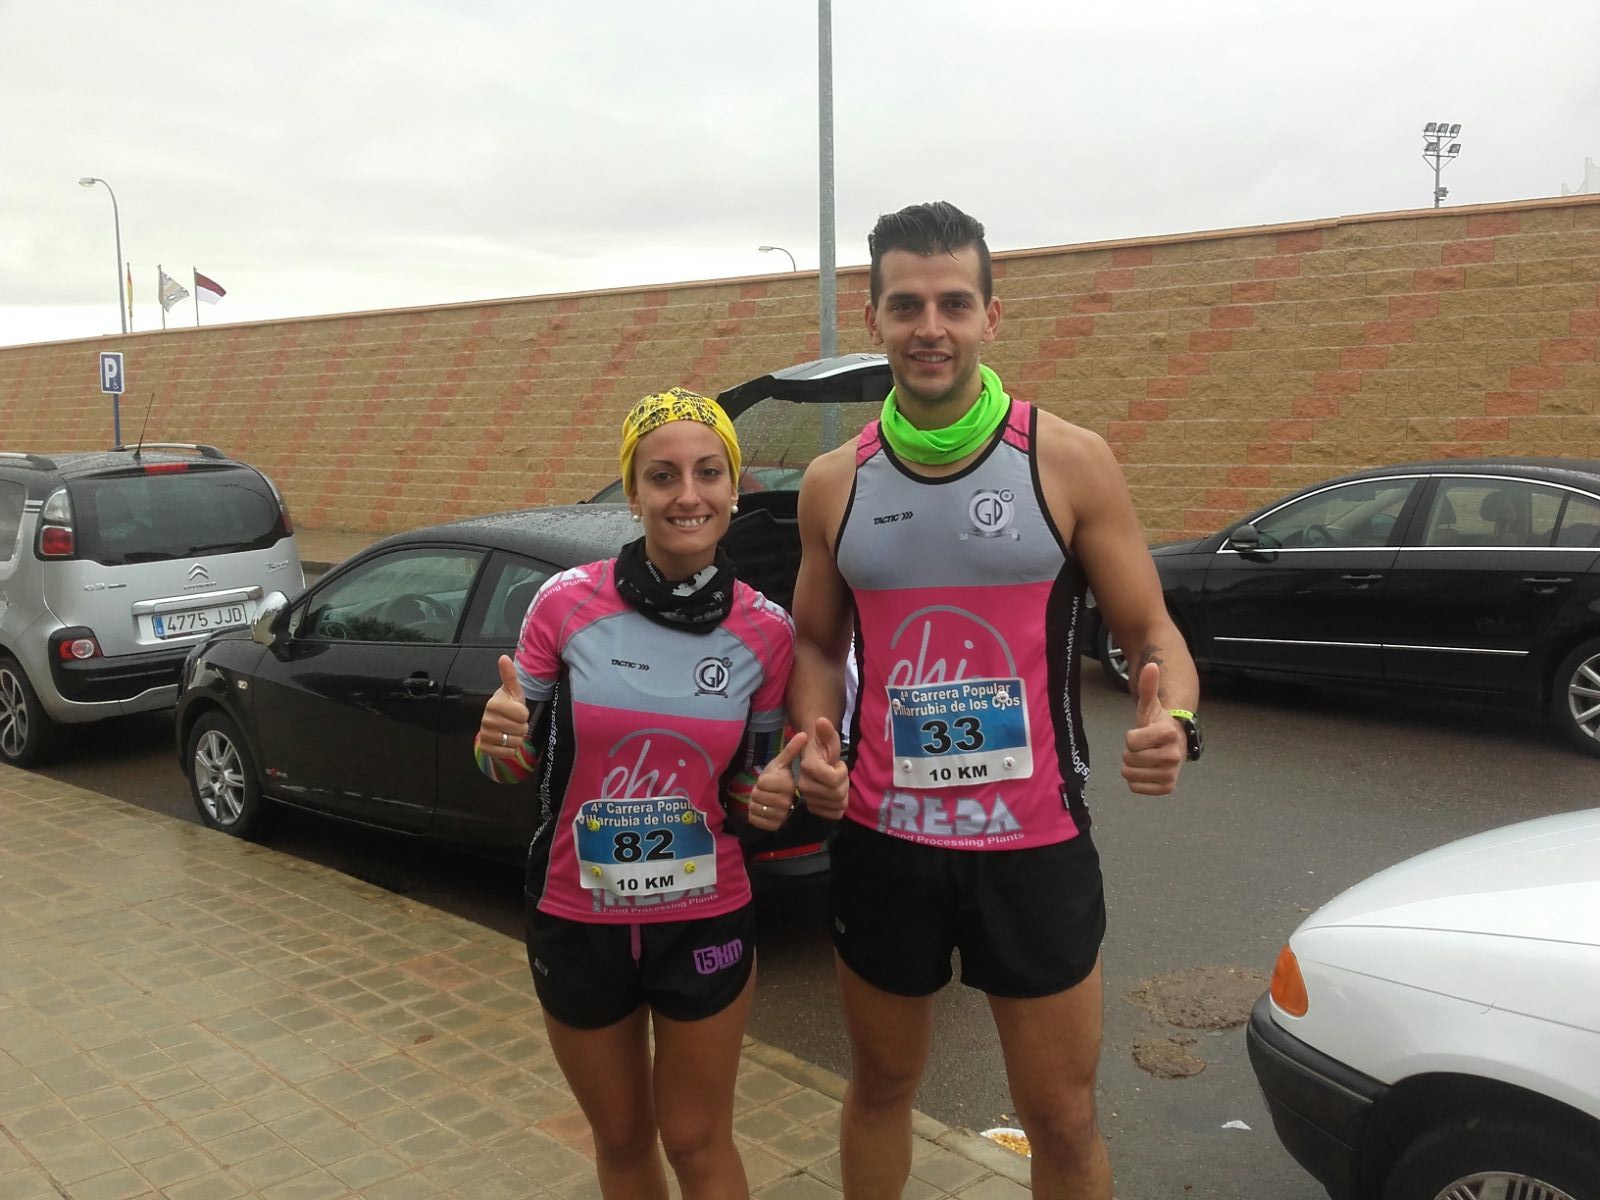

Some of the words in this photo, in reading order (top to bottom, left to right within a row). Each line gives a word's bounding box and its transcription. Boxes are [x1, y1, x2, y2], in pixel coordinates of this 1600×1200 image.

[104, 357, 118, 388] P
[873, 514, 900, 525] TACTIC
[167, 614, 209, 631] 4775
[214, 606, 243, 624] JJD
[611, 659, 636, 669] TACTIC
[911, 689, 960, 702] Carrera
[962, 683, 1011, 698] Popular
[951, 700, 966, 713] de
[969, 698, 988, 711] los
[921, 716, 986, 756] 33
[929, 769, 952, 782] 10
[958, 764, 988, 779] KM
[606, 801, 653, 815] Carrera
[644, 814, 659, 825] de
[663, 813, 681, 824] los
[612, 828, 675, 864] 82
[917, 835, 985, 848] Processing
[987, 832, 1025, 846] Plants
[616, 877, 639, 892] 10
[645, 874, 675, 890] KM
